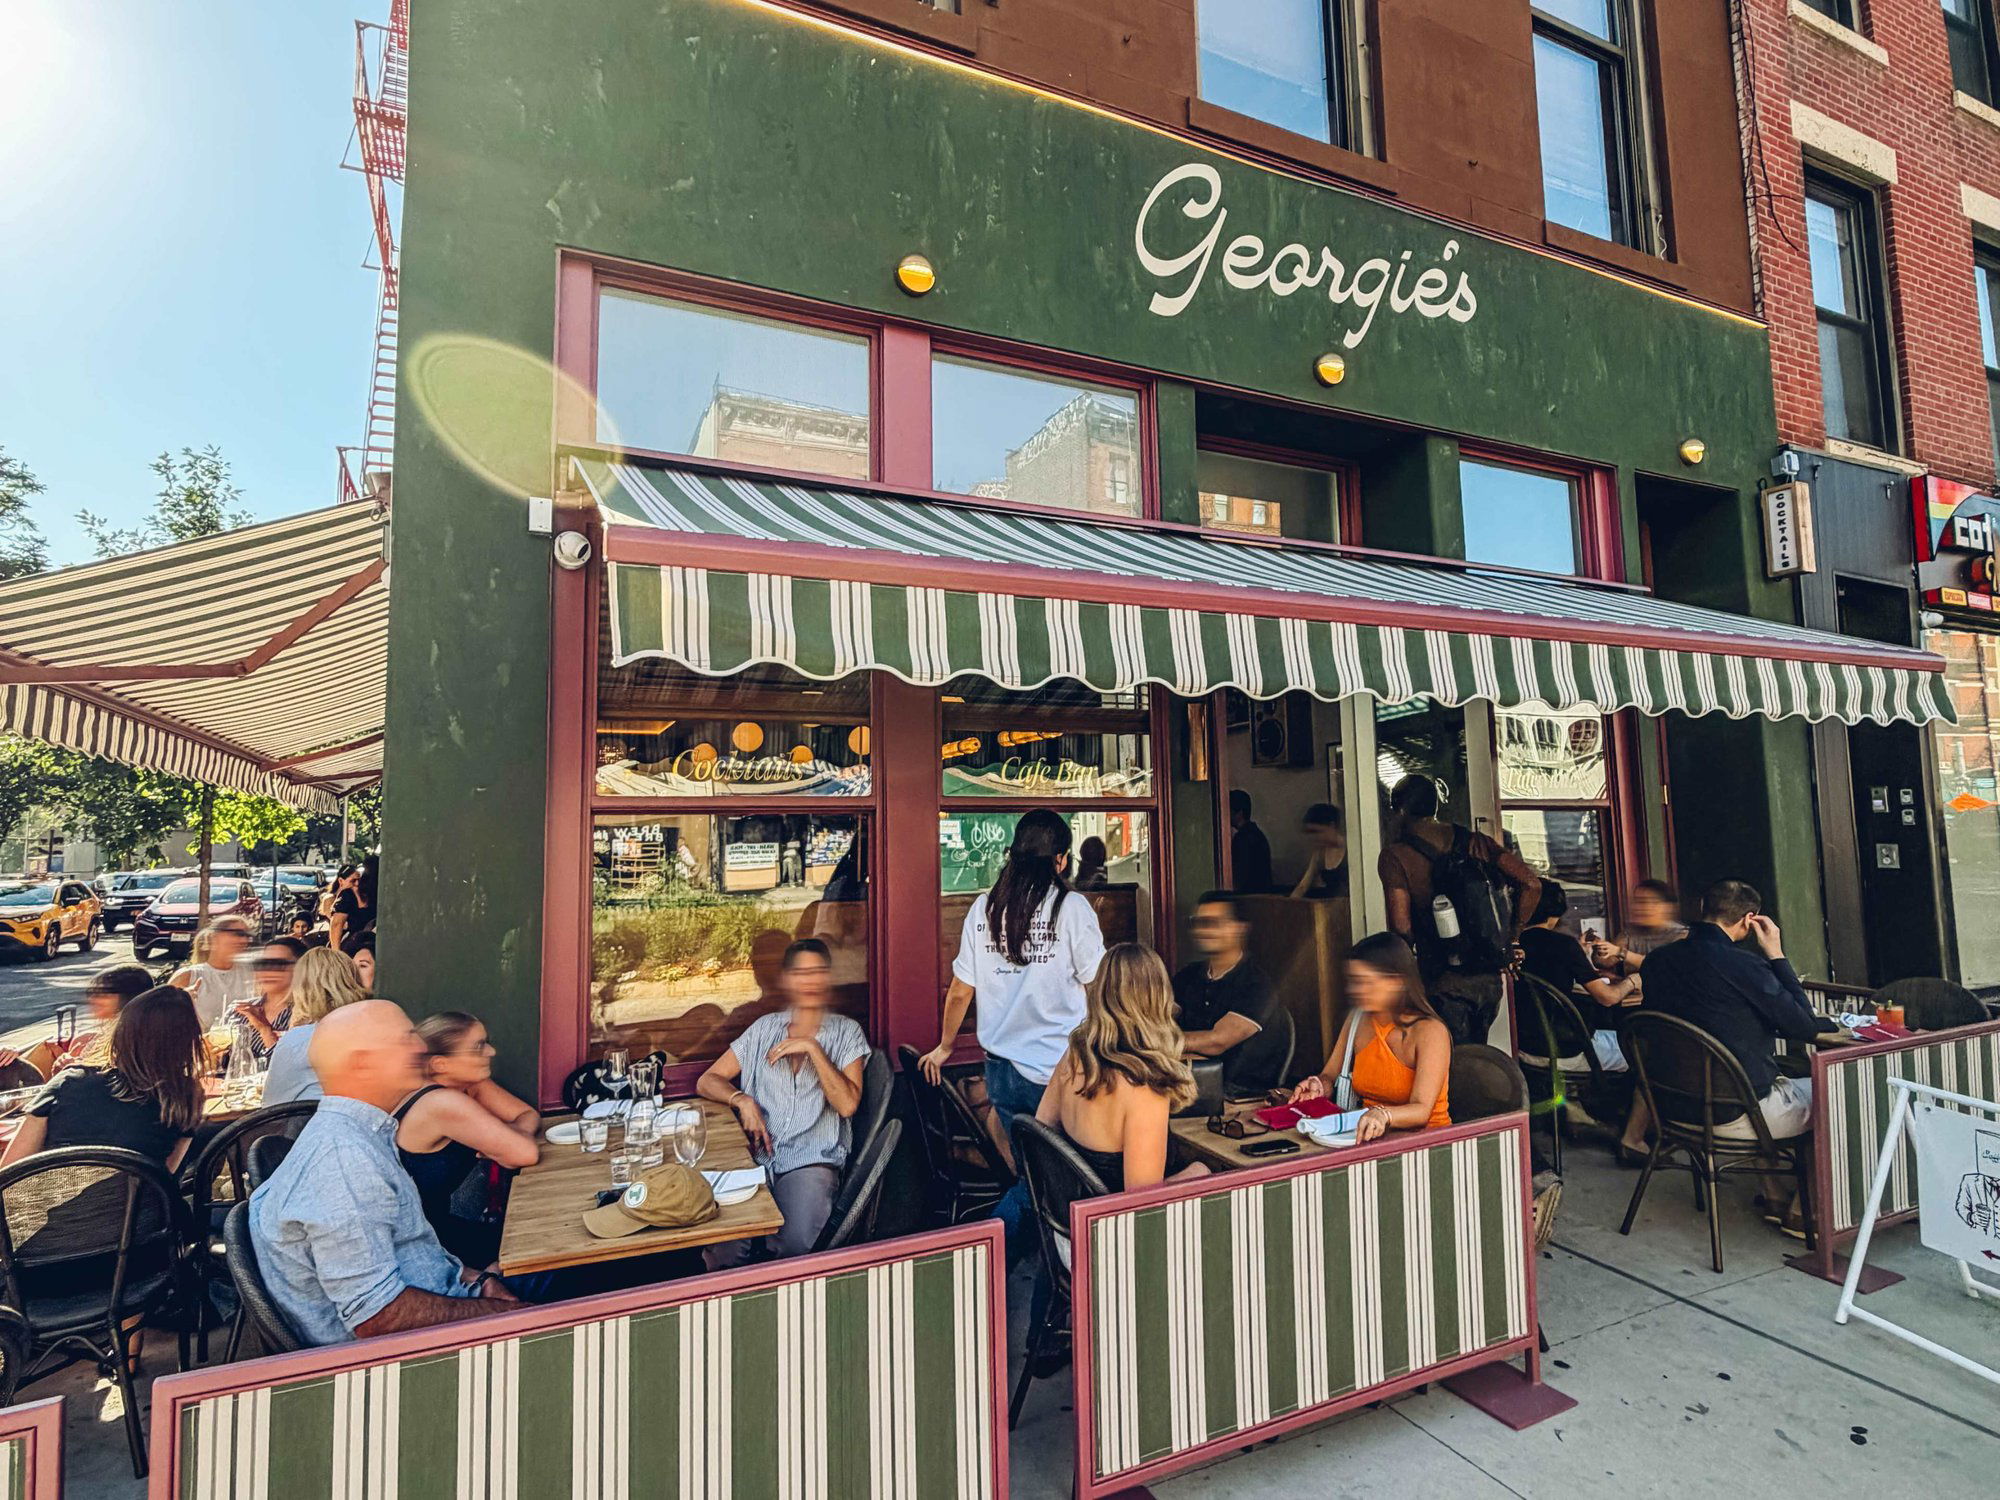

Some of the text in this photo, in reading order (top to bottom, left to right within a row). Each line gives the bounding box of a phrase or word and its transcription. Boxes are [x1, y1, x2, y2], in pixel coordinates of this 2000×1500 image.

[1135, 163, 1477, 349] Georgie's
[1775, 493, 1790, 568] COCKTAILS
[672, 749, 803, 782] Cocktails
[1001, 756, 1099, 789] Cafe Bar
